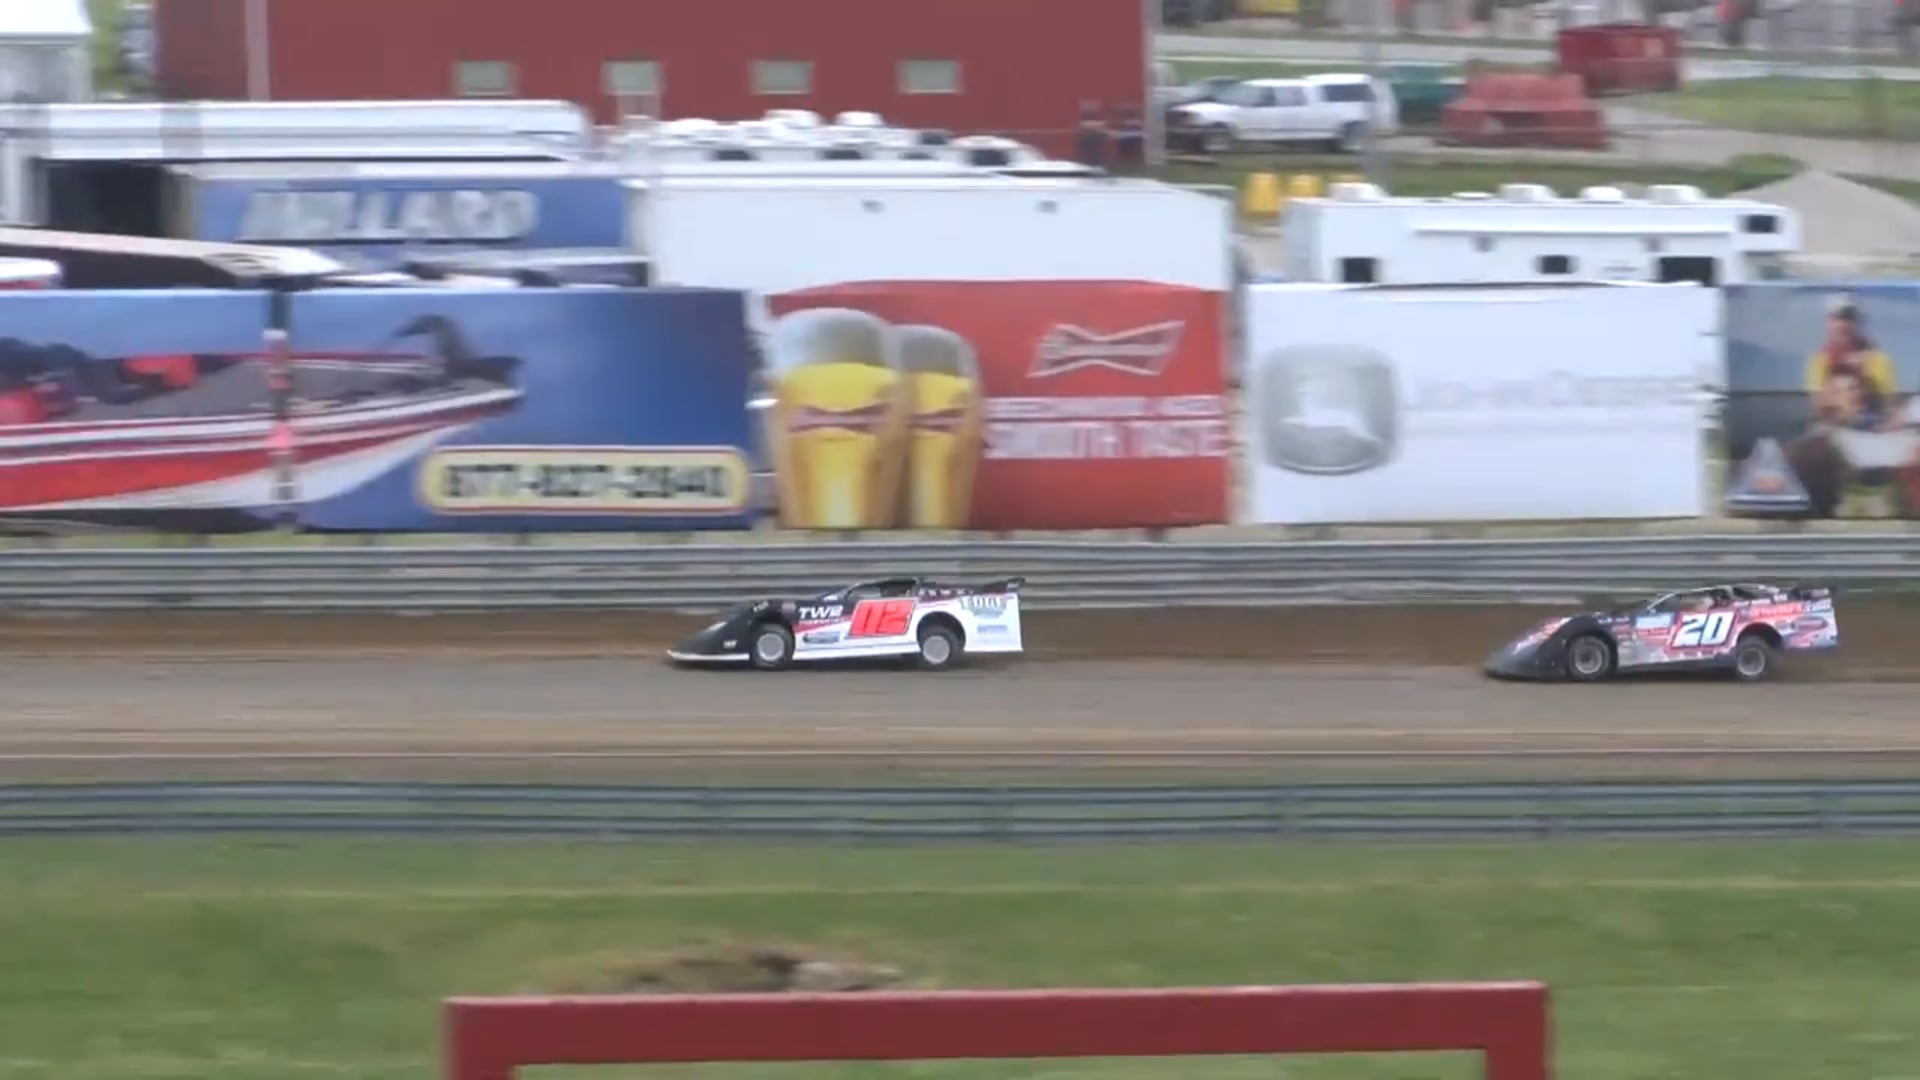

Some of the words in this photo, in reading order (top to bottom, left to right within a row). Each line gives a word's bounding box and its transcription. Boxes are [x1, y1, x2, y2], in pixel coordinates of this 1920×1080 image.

[985, 422, 1118, 459] SMOOTH
[1122, 419, 1227, 458] TASTE
[1672, 611, 1734, 648] 20
